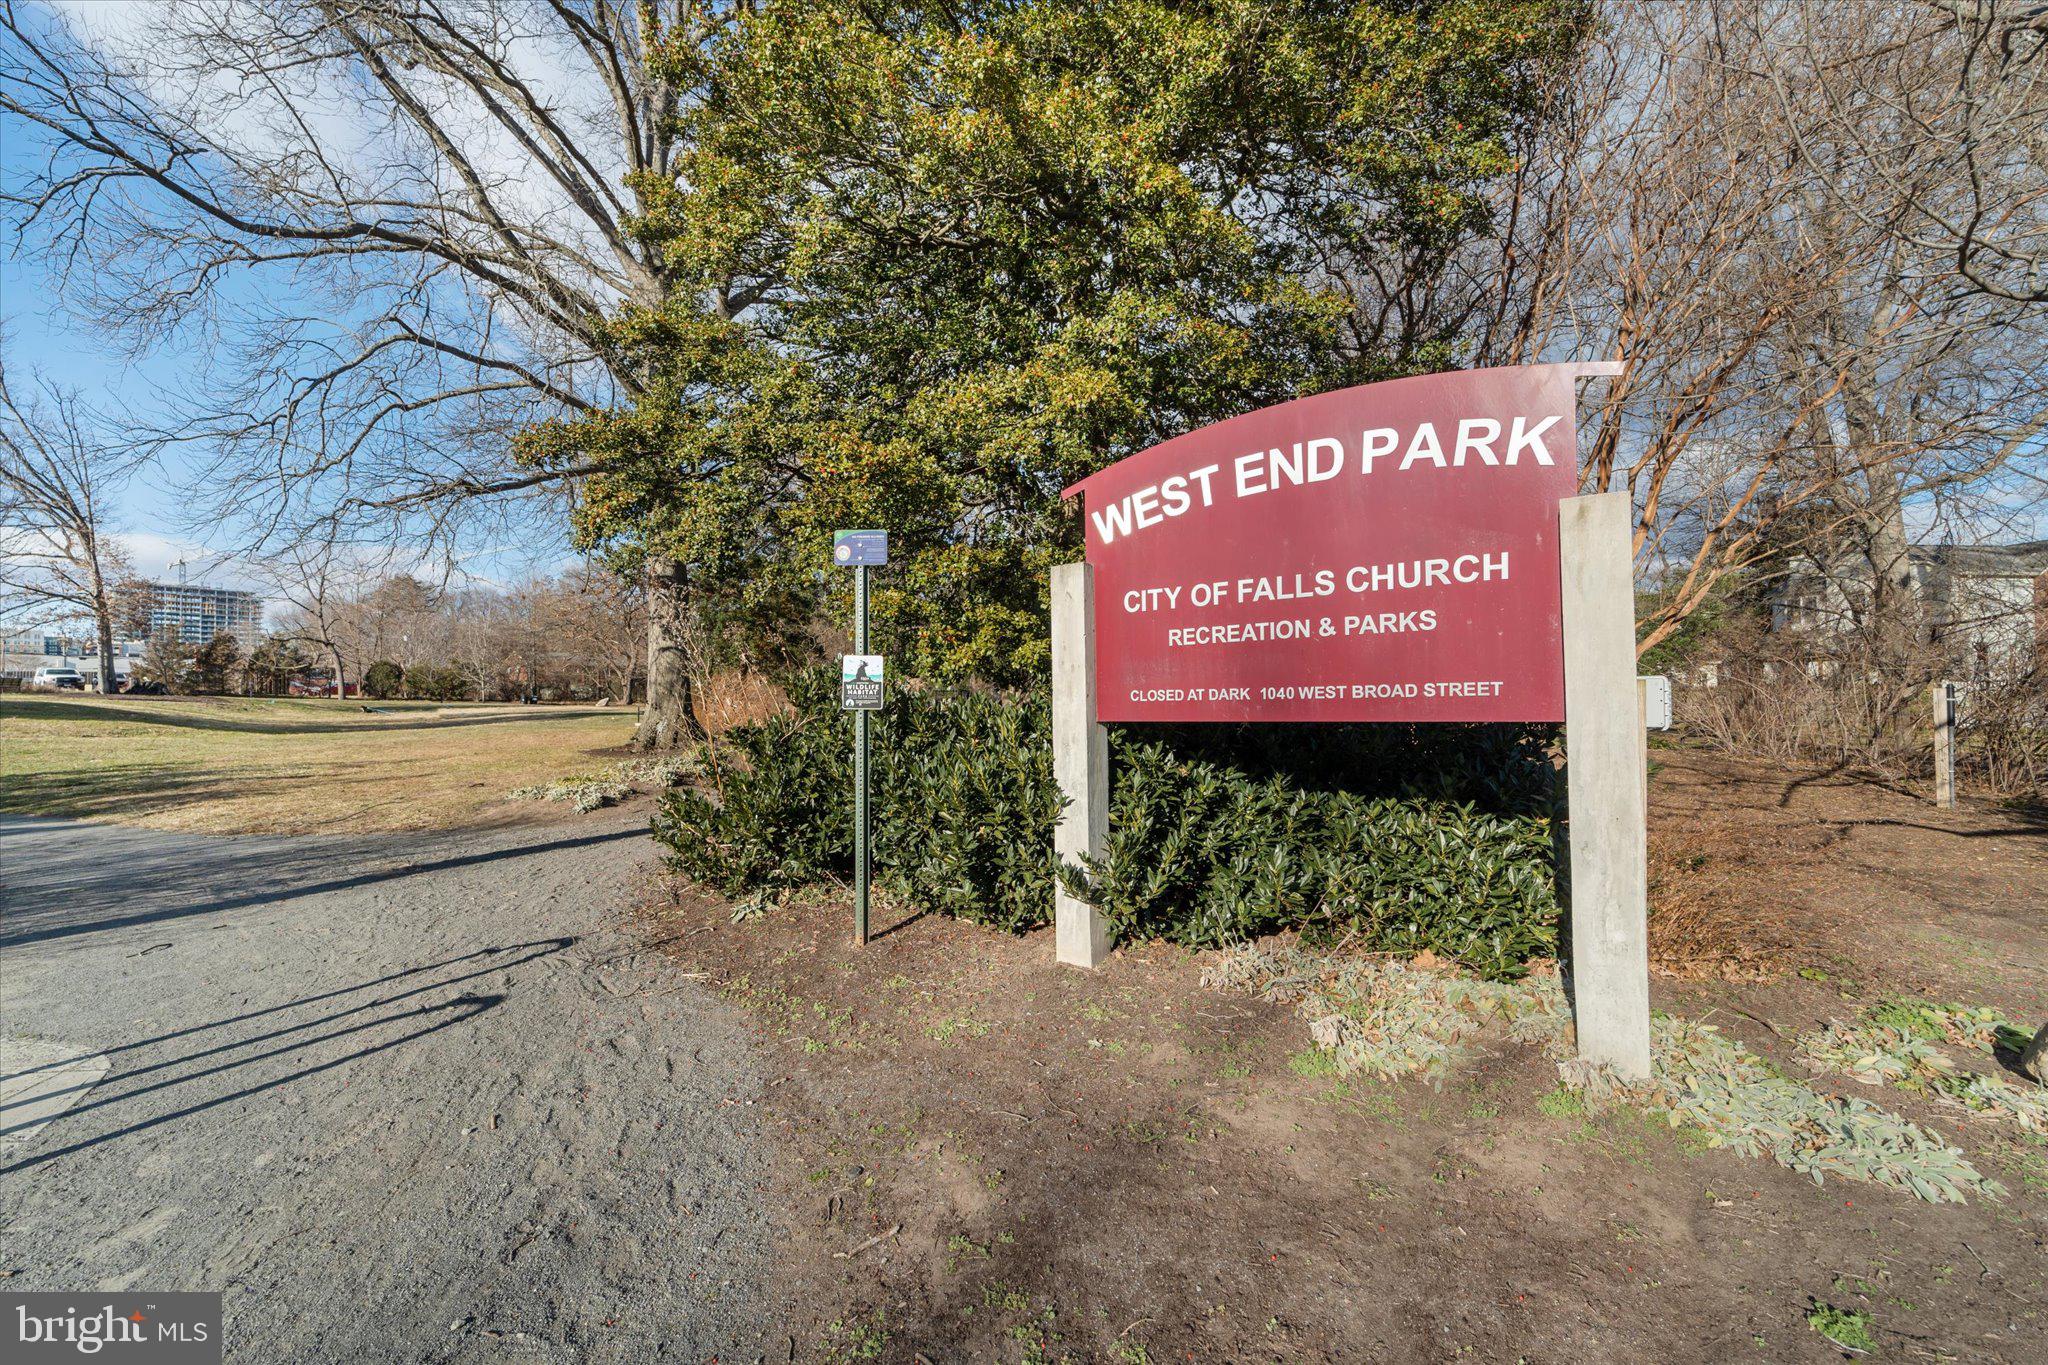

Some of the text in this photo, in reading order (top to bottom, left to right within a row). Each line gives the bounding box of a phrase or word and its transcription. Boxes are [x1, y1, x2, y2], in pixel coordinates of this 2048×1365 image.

[1091, 415, 1563, 544] WEST END PARK
[1124, 551, 1510, 613] CITY OF FALLS CHURCH
[1168, 609, 1437, 647] RECREATION & PARKS
[1130, 681, 1504, 702] CLOSED AT DARK 1040 WEST BROAD STREET
